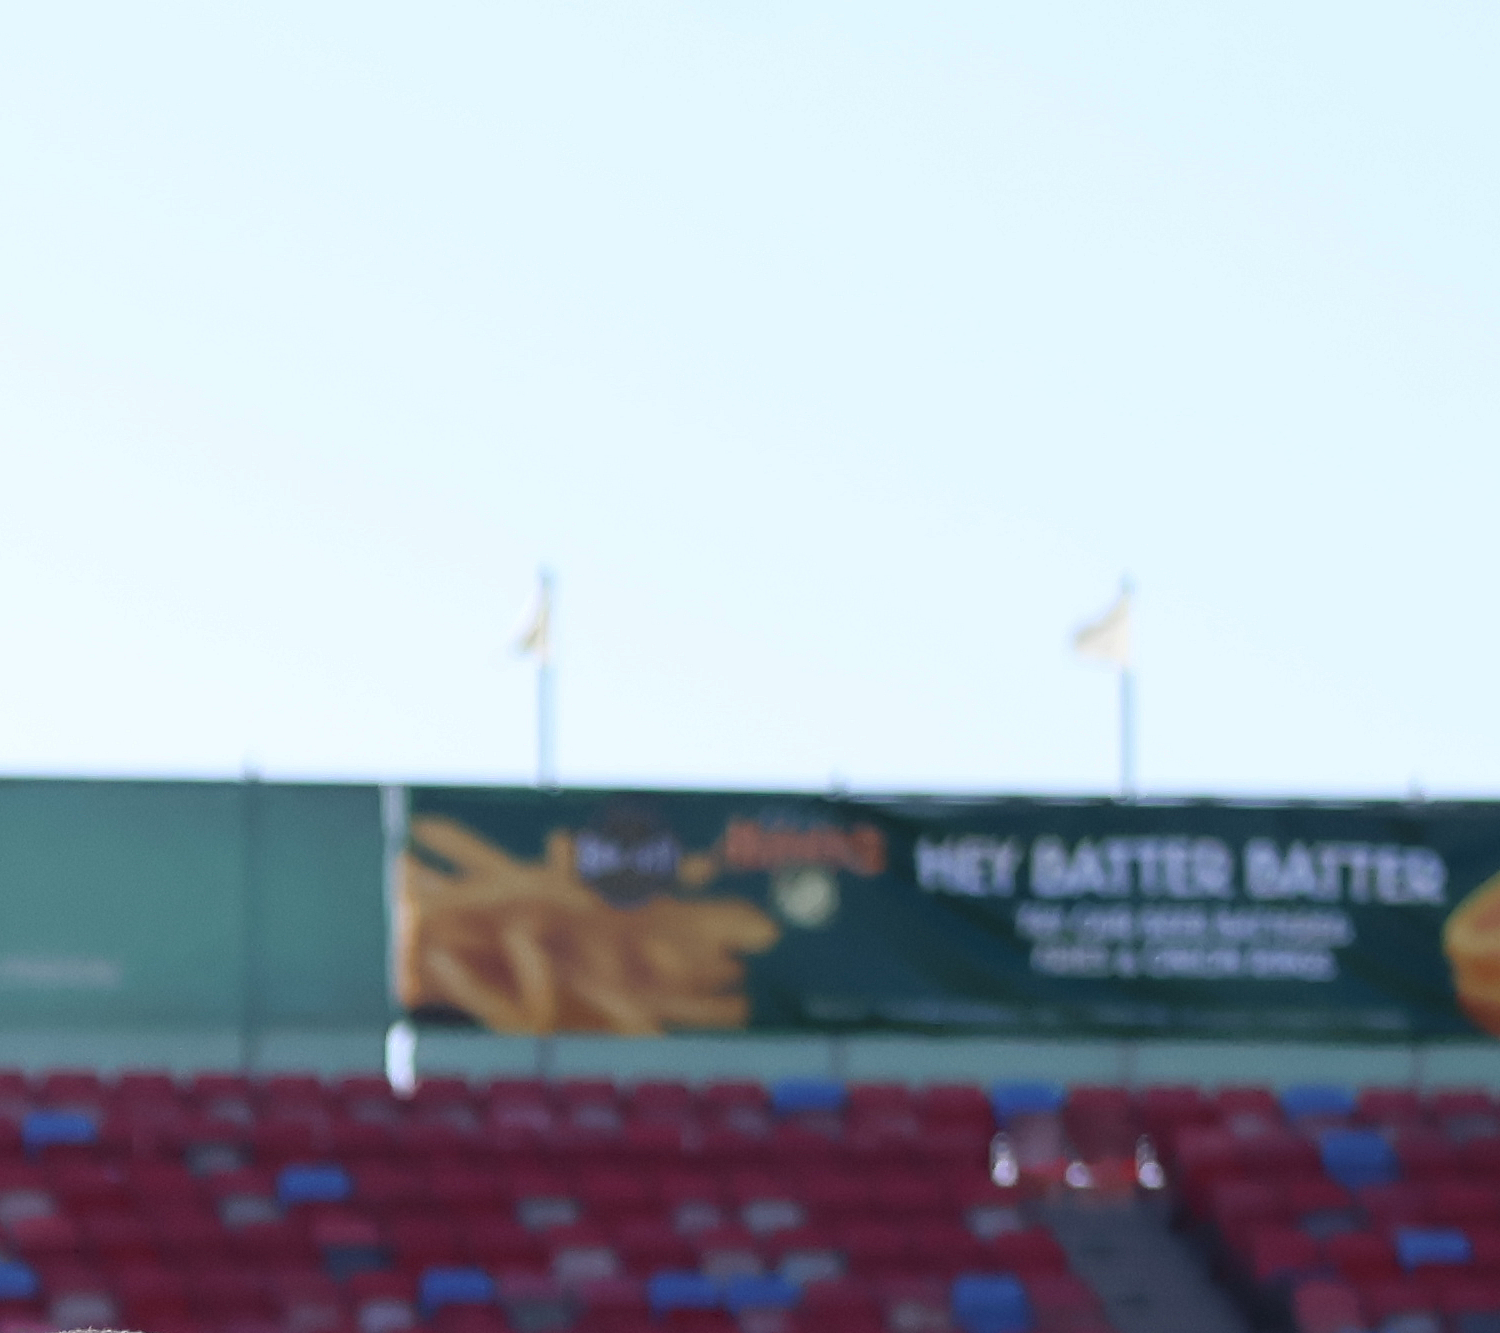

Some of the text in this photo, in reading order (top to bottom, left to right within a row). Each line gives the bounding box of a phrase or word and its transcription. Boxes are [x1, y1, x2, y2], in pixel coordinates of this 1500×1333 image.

[916, 836, 1017, 898] HEY
[1030, 836, 1234, 902] BATTER
[1243, 838, 1448, 906] BATTER
